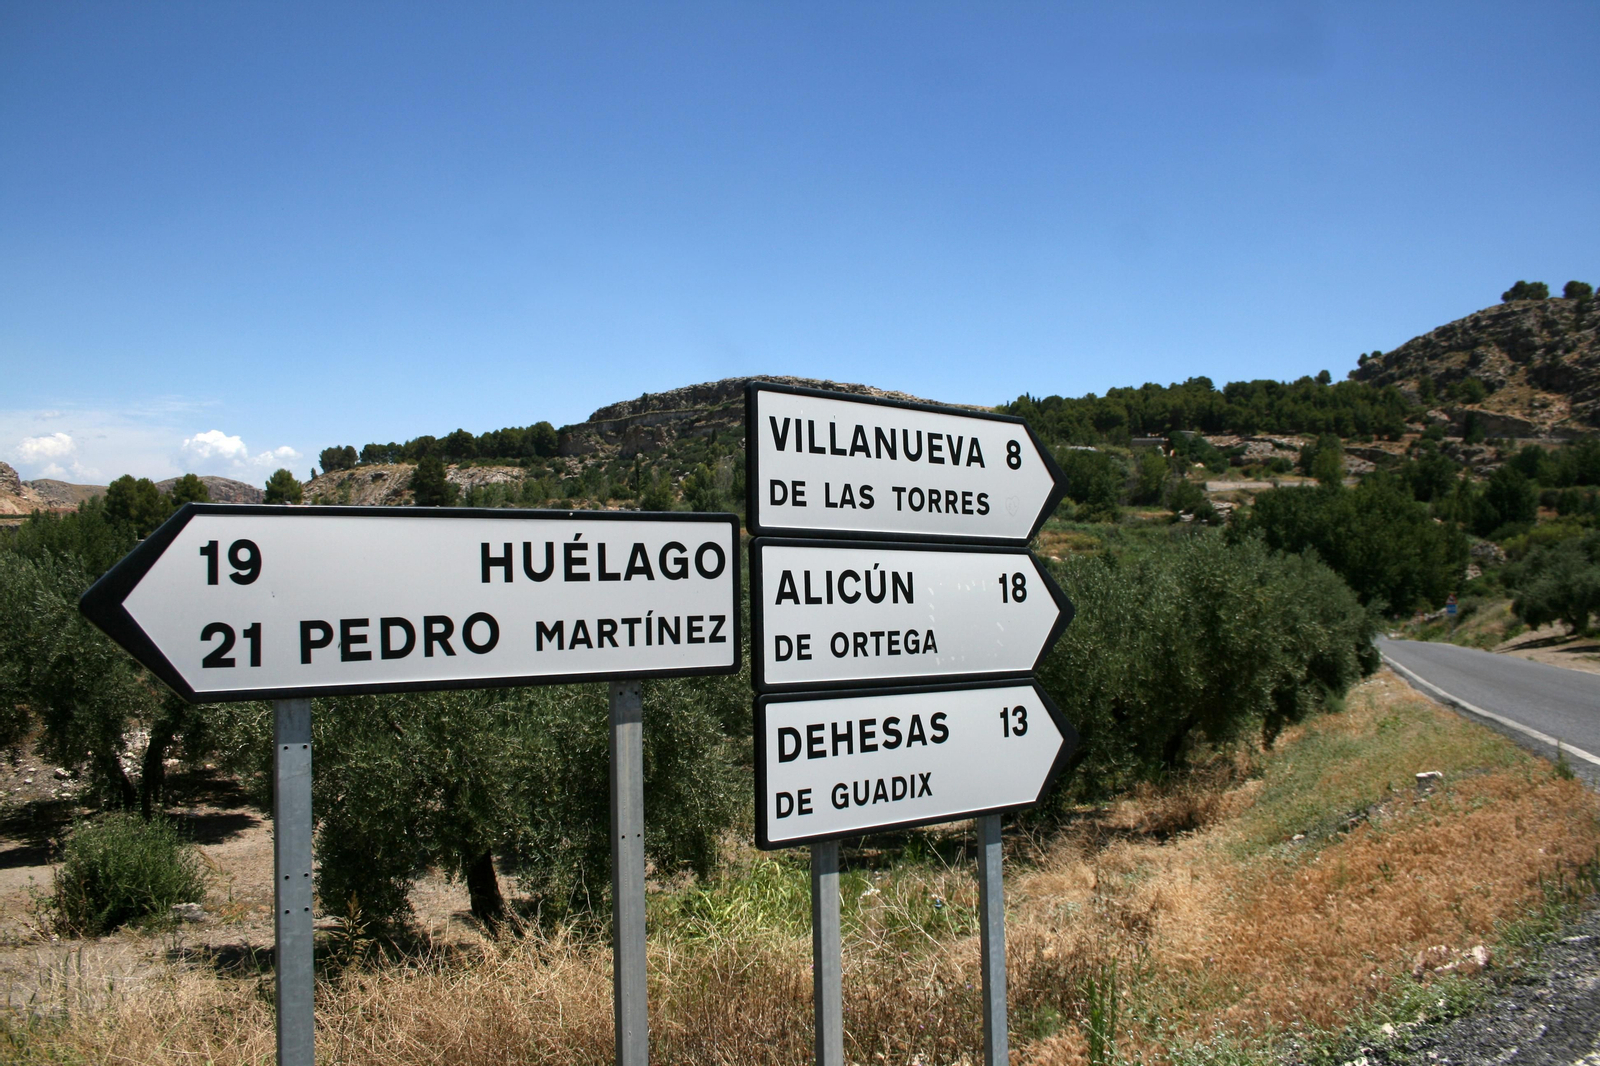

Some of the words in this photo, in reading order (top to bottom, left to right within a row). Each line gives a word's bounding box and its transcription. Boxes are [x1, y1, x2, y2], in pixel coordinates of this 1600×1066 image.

[769, 416, 985, 468] VILLANUEVA
[1006, 439, 1022, 470] 8
[770, 480, 807, 507] DE
[825, 482, 875, 510] LAS
[892, 486, 990, 516] TORRES
[199, 539, 261, 585] 19
[481, 533, 726, 583] HUÉLAGO
[775, 562, 914, 605] ALICÚN
[998, 573, 1027, 603] 18
[201, 622, 262, 668] 21
[300, 612, 500, 664] PEDRO
[536, 610, 727, 651] MARTÍNEZ
[775, 634, 812, 661] DE
[830, 629, 938, 658] ORTEGA
[777, 712, 949, 763] DEHESAS
[1000, 705, 1028, 737] 13
[776, 788, 813, 819] DE
[832, 772, 933, 809] GUADIX
